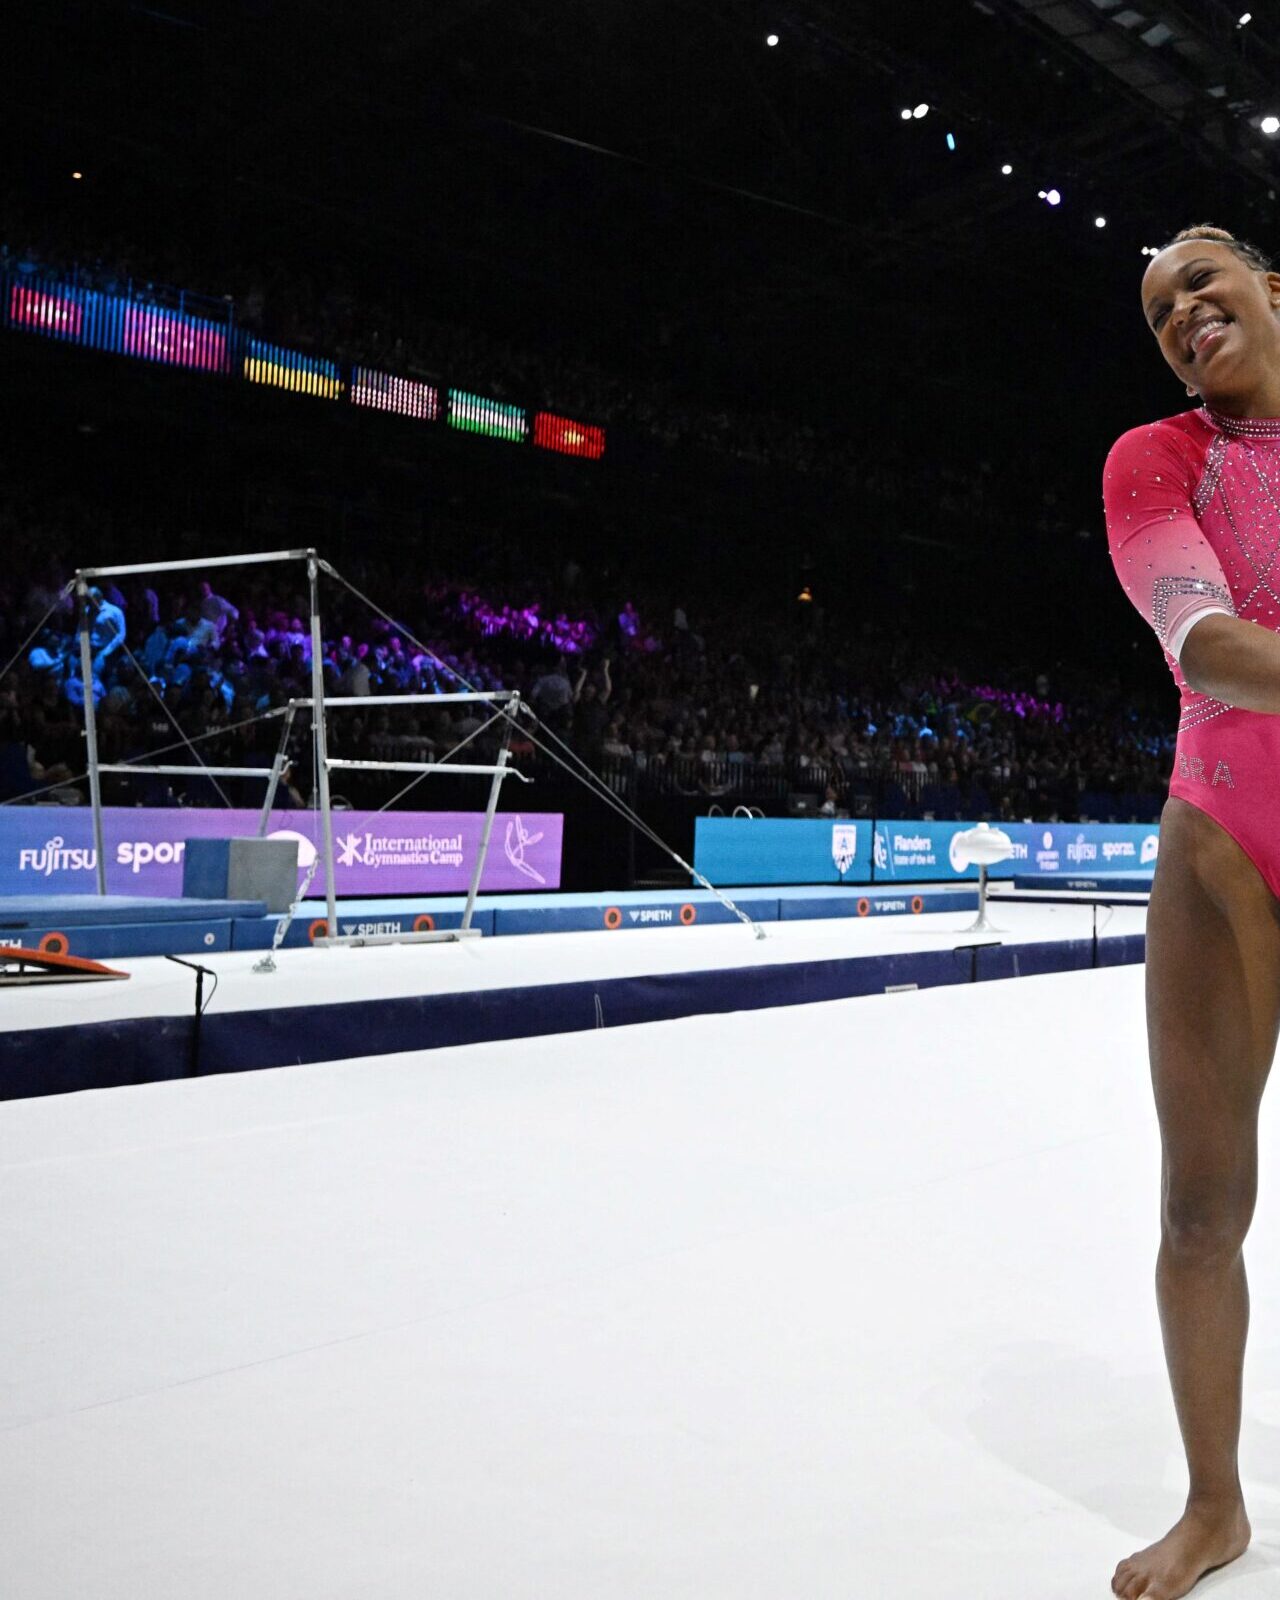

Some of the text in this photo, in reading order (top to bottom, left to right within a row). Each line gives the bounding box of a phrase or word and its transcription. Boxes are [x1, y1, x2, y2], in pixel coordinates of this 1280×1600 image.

[1180, 752, 1235, 789] BRA
[365, 833, 463, 851] International
[894, 835, 931, 850] Flanders
[1067, 838, 1097, 864] FUJITSU
[20, 838, 96, 876] FUJITSU
[117, 841, 186, 873] spor
[363, 850, 463, 868] Gymnastics Camp
[640, 910, 671, 922] SPIETH
[358, 922, 400, 935] SPIETH
